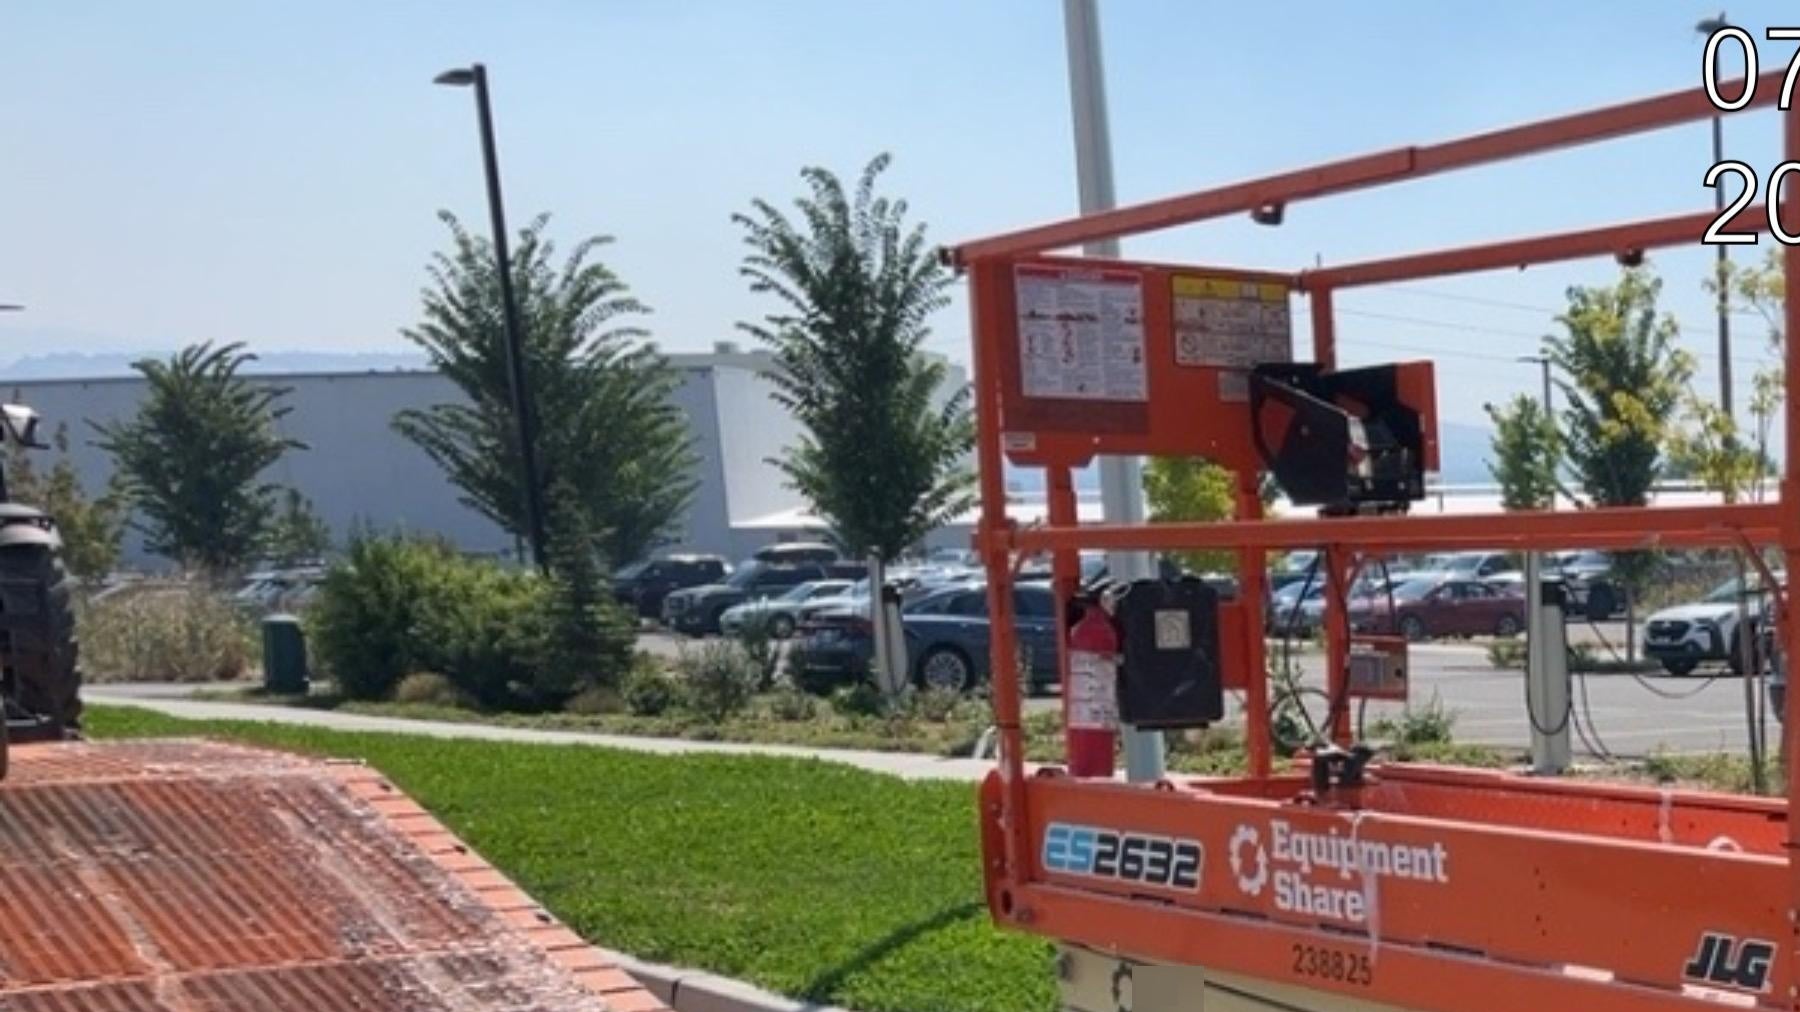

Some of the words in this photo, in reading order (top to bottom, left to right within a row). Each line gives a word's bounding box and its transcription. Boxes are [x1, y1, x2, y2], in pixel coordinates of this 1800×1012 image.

[1046, 827, 1201, 890] ES2632
[1271, 819, 1449, 883] Equipment
[1273, 869, 1366, 921] Share
[1292, 943, 1373, 986] 238825
[1684, 931, 1777, 992] JLG
